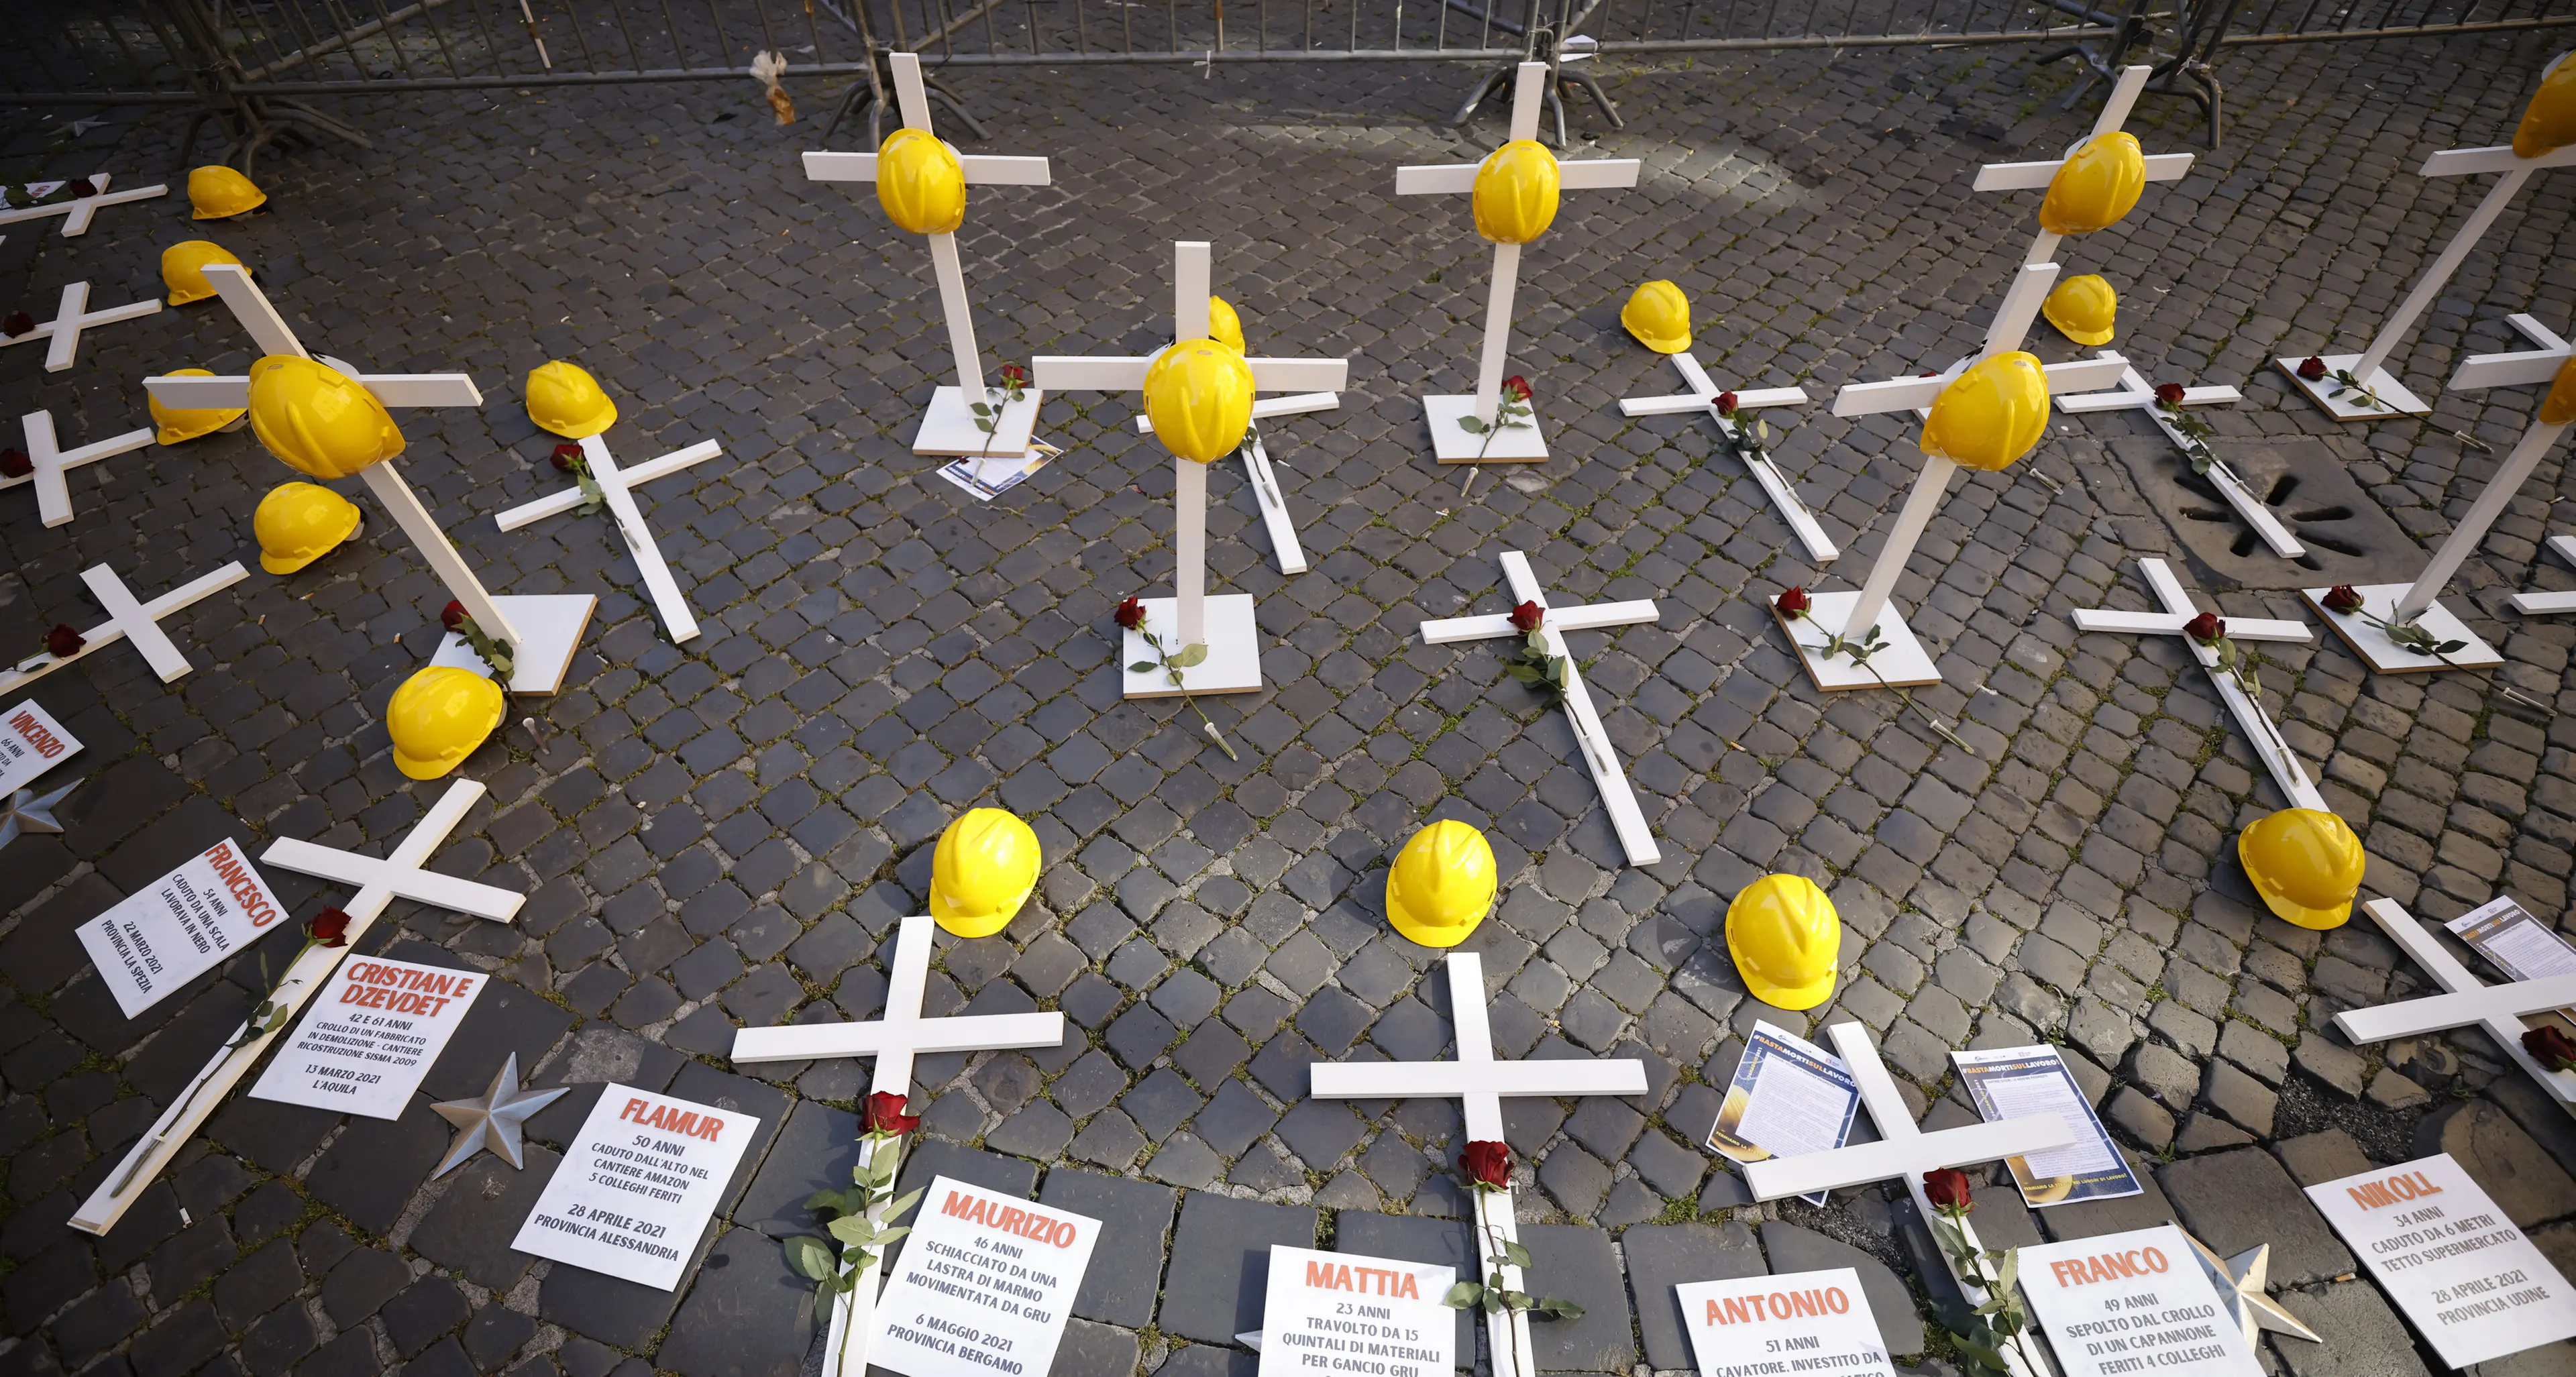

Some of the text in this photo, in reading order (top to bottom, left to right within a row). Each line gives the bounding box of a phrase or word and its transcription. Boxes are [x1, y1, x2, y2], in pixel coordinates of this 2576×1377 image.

[1, 738, 13, 747] 66
[7, 744, 25, 758] ANNI
[9, 710, 65, 759] VINCENZO
[2, 758, 12, 767] DA
[205, 842, 276, 927] FRANCESCO
[172, 874, 229, 951] CADUTO DA UNA SCALA
[203, 889, 228, 917] 54 ANNI
[161, 889, 211, 954] LAVORAVA IN NERO
[101, 920, 152, 994] PROVINCIA LA SPEZIA
[123, 921, 163, 975] 22 MARZO 2021
[347, 962, 474, 998] CRISTIAN E
[339, 983, 450, 1017] DZEVDET
[317, 1022, 348, 1032] CROLLO
[361, 1029, 374, 1037] UN
[374, 1030, 426, 1045] FABBRICATO
[349, 1013, 413, 1030] 42 E 61 ANNI
[297, 1042, 417, 1066] RICOSTRUZIONE SISMA 2009
[319, 1034, 375, 1048] DEMOLIZIONE
[382, 1044, 423, 1056] CANTIERE
[305, 1064, 381, 1084] 13 MARZO 2021
[313, 1080, 357, 1095] L'AQUILA
[620, 1097, 724, 1142] FLAMUR
[592, 1142, 709, 1180] CADUTO DALL'ALTO NEL
[632, 1135, 686, 1157] 50 ANNI
[588, 1172, 683, 1204] 5 COLLEGHI FERITI
[594, 1158, 690, 1190] CANTIERE AMAZON
[2347, 1170, 2443, 1211] NIKOLL
[568, 1204, 667, 1239] 28 APRILE 2021
[941, 1191, 1076, 1249] MAURIZIO
[2393, 1206, 2445, 1228] 34 ANNI
[534, 1214, 680, 1262] PROVINCIA ALESSANDRIA
[974, 1237, 1024, 1260] 46 ANNI
[2371, 1214, 2496, 1255] CADUTO DA 6 METRI
[2381, 1229, 2518, 1273] TETTO SUPERMERCATO
[926, 1240, 1057, 1288] SCHIACCIATO DA UNA
[1306, 1260, 1419, 1300] MATTIA
[2050, 1246, 2169, 1288] FRANCO
[906, 1272, 1051, 1324] MOVIMENTATA DA GRU
[927, 1260, 1042, 1303] LASTRA DI MARMO
[2431, 1270, 2528, 1304] 28 APRILE 2021
[1336, 1303, 1391, 1319] 23 ANNI
[1707, 1286, 1849, 1327] ANTONIO
[2104, 1292, 2160, 1312] 49 ANNI
[2437, 1286, 2551, 1326] PROVINCIA UDINE
[916, 1314, 1014, 1352] 6 MAGGIO 2021
[1307, 1317, 1419, 1341] TRAVOLTO DA 15
[2065, 1304, 2216, 1339] SEPOLTO DAL CROLLO
[887, 1324, 1023, 1375] PROVINCIA BERGAMO
[1283, 1333, 1440, 1363] QUINTALI DI MATERIALI
[1766, 1335, 1820, 1352] 51 ANNI
[2086, 1325, 2216, 1356] DI UN CAPANNONE
[1302, 1354, 1419, 1377] PER GANCIO GRU
[1792, 1354, 1860, 1372] INVESTITO
[1862, 1352, 1882, 1364] DA
[2098, 1344, 2226, 1376] FERITI 4 COLLEGHI
